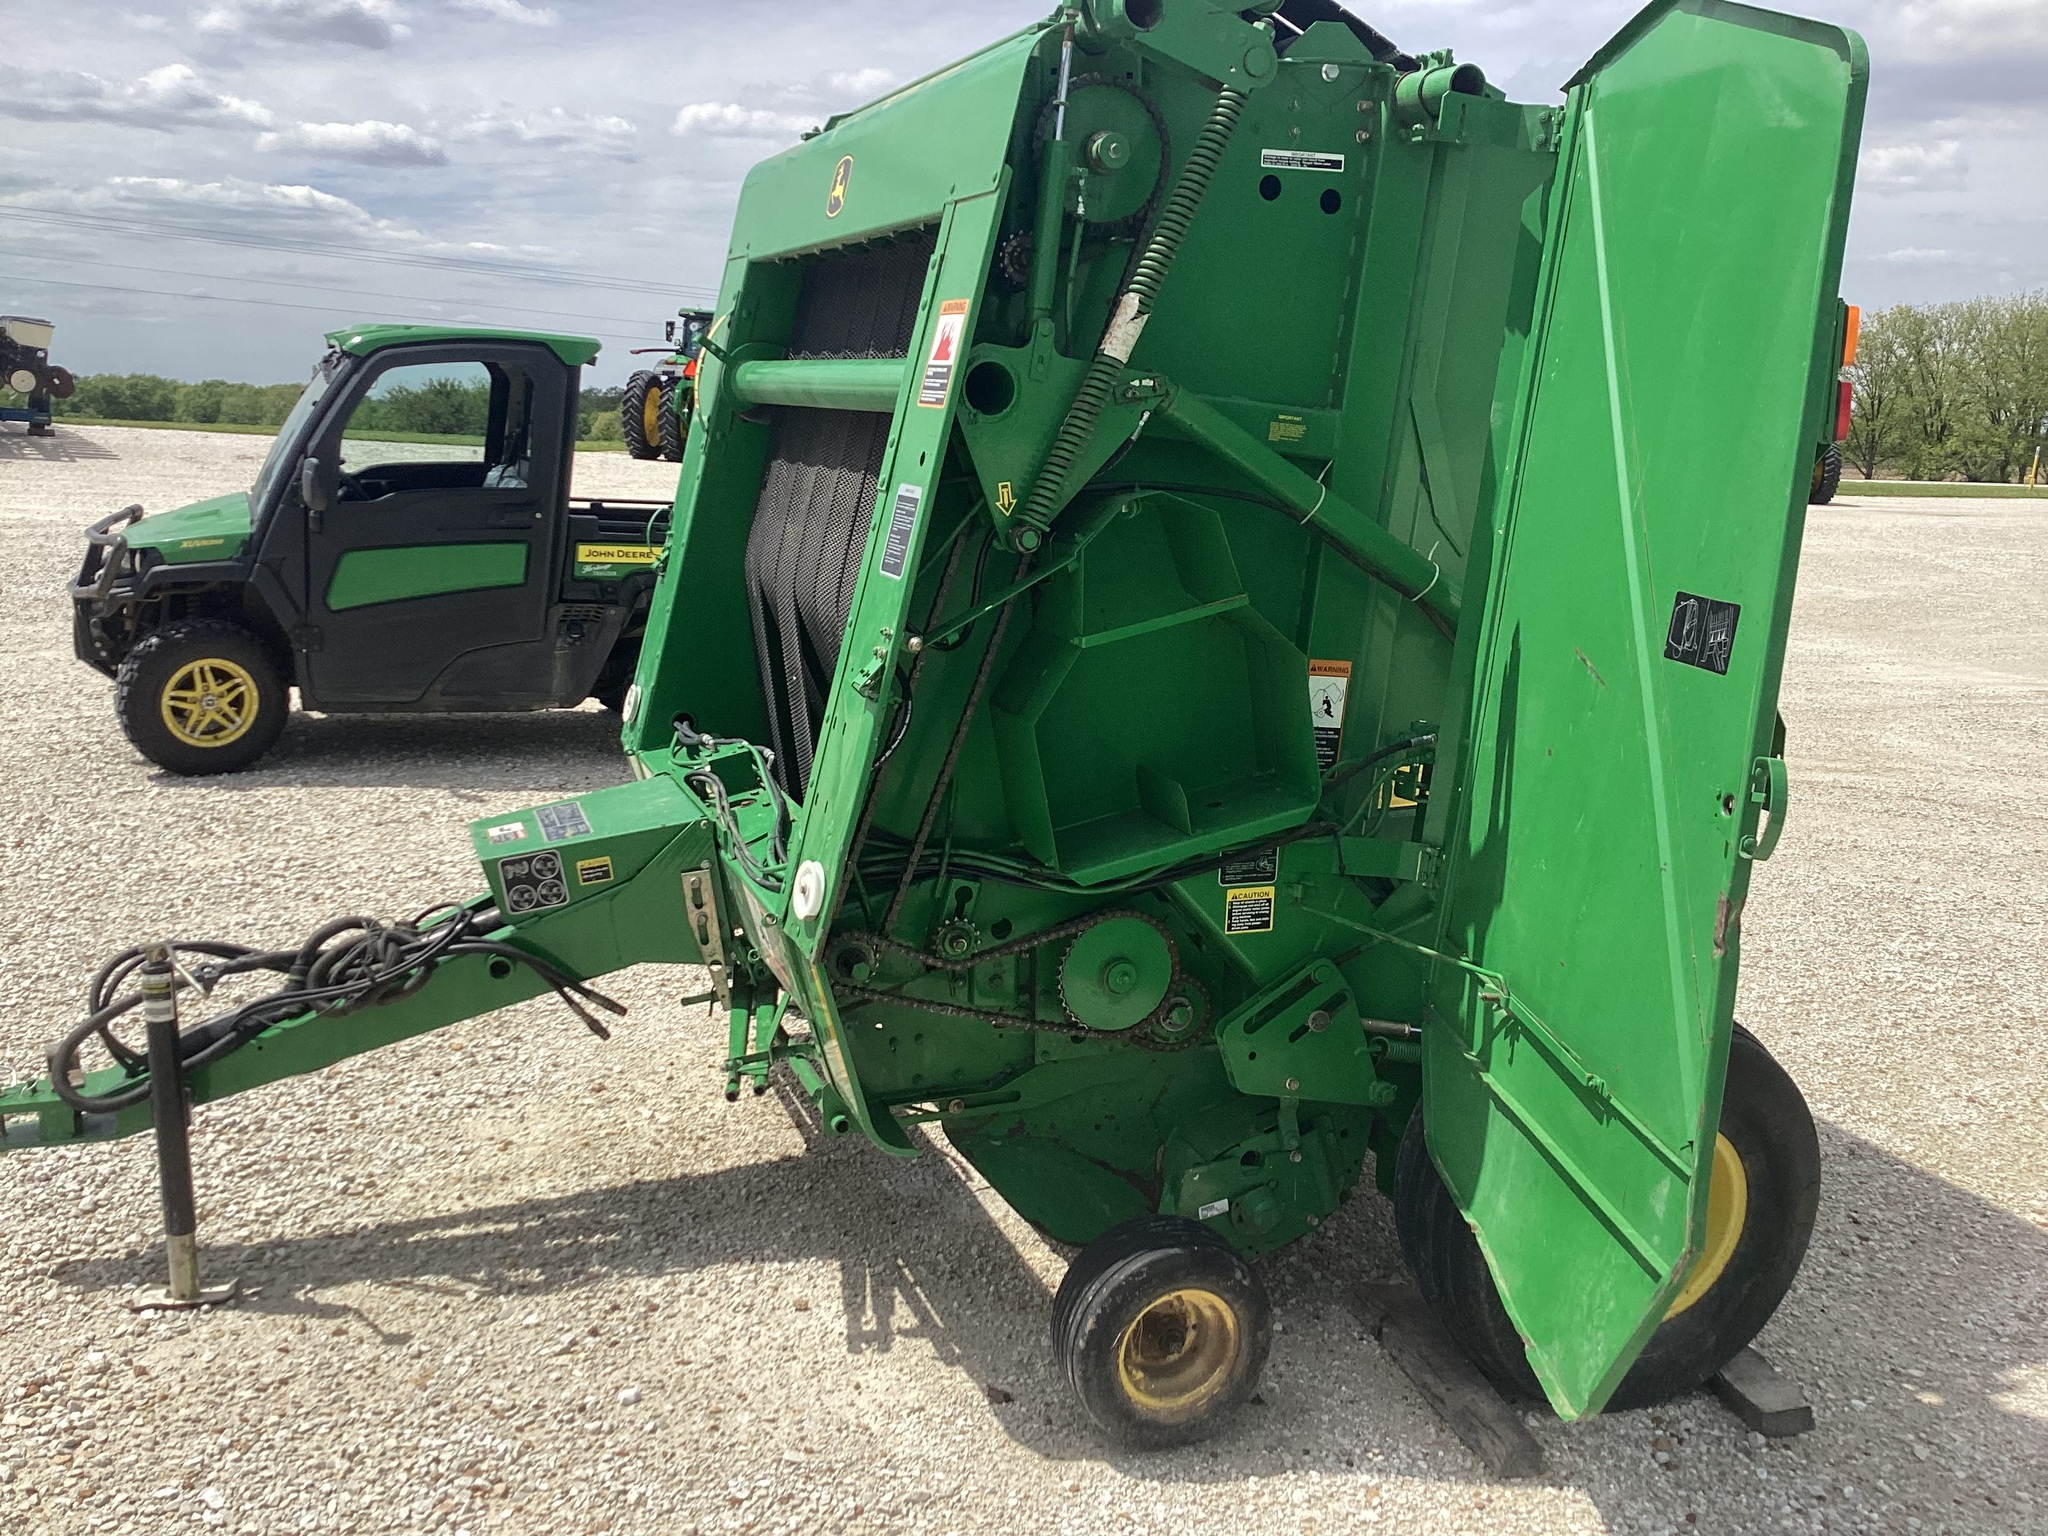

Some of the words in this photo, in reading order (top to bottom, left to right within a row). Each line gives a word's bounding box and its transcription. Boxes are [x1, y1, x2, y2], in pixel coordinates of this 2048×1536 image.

[946, 301, 967, 312] WARNING
[585, 549, 615, 558] JOHN
[617, 549, 653, 559] DEERE
[1316, 665, 1349, 674] WARNING
[1238, 891, 1270, 900] CAUTION
